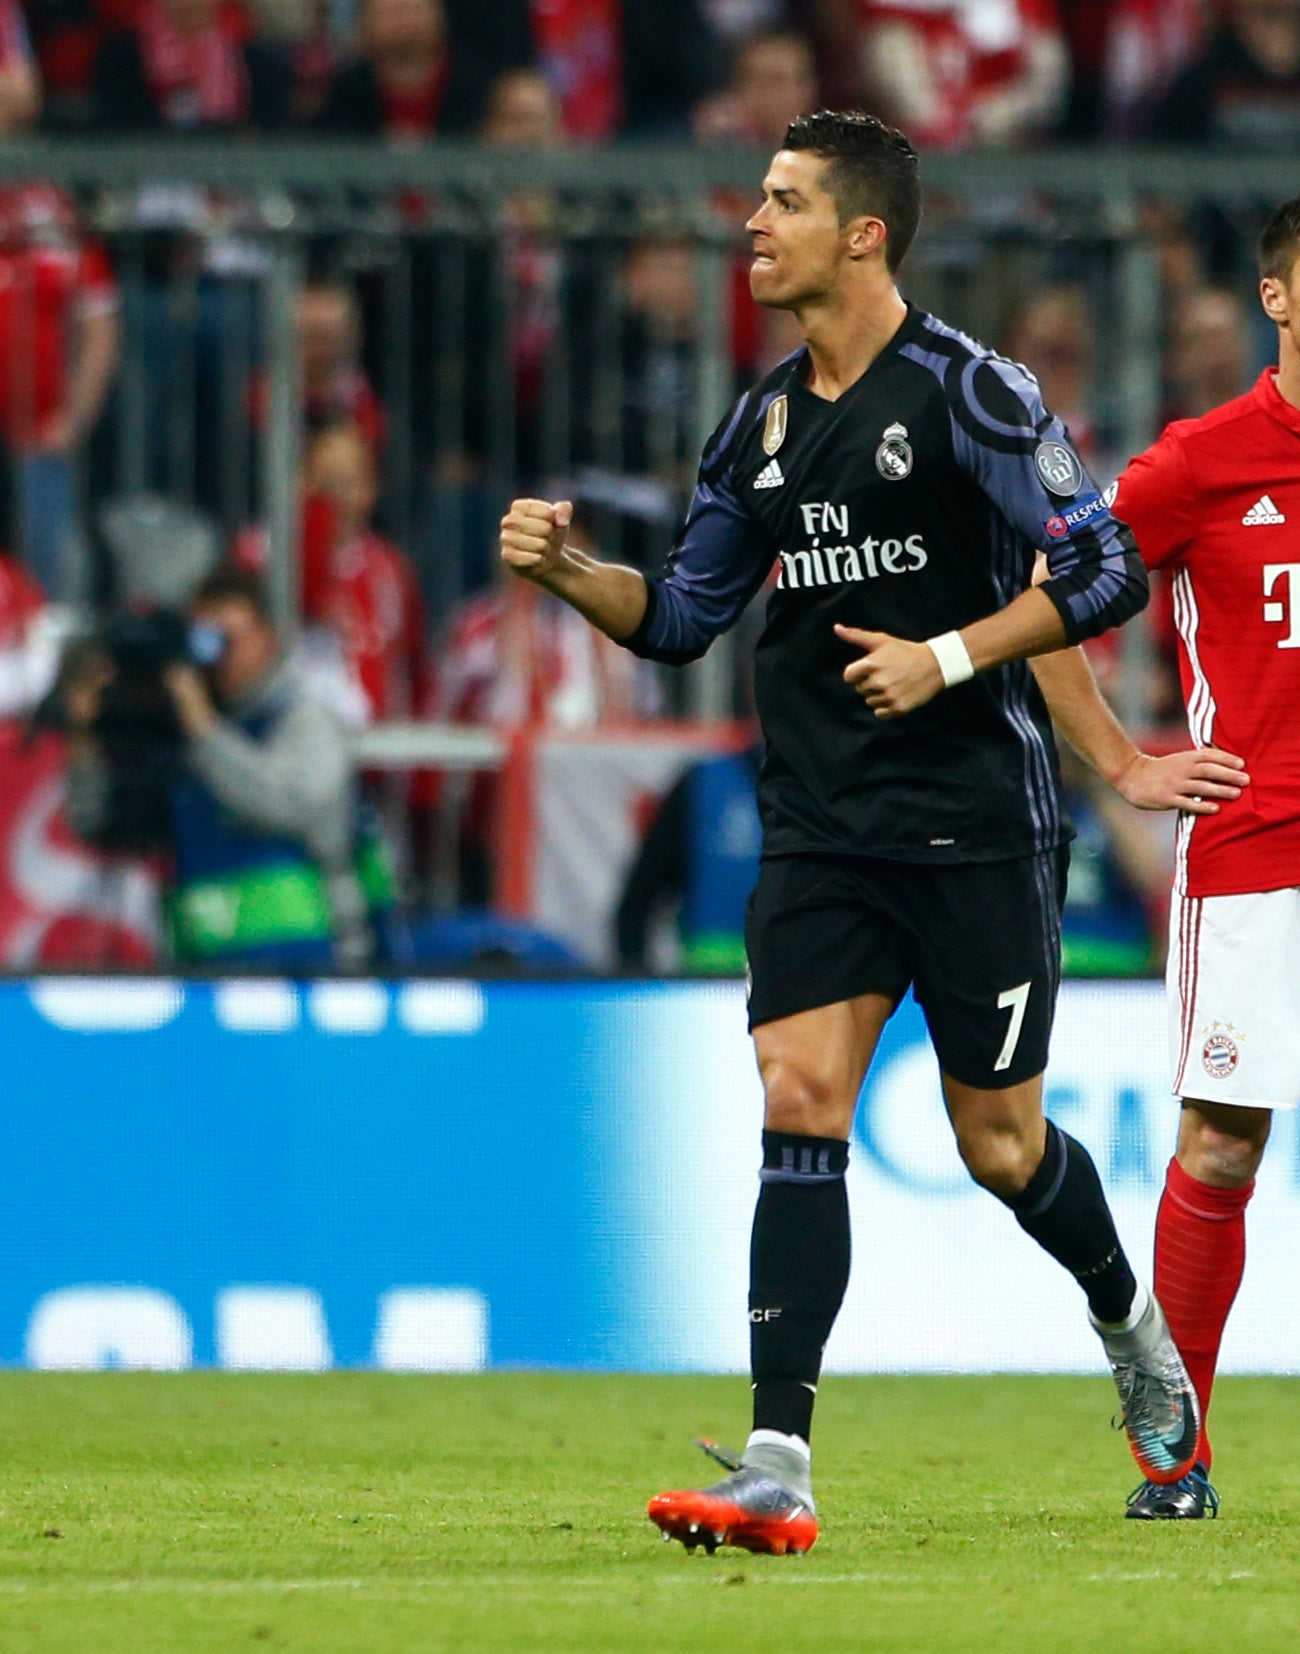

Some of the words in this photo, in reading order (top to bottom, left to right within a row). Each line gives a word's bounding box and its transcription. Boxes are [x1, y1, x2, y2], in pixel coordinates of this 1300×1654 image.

[754, 477, 785, 489] adidas
[800, 501, 849, 537] Fly
[1242, 513, 1286, 526] adidas
[777, 534, 928, 590] mirates
[994, 981, 1032, 1072] 7
